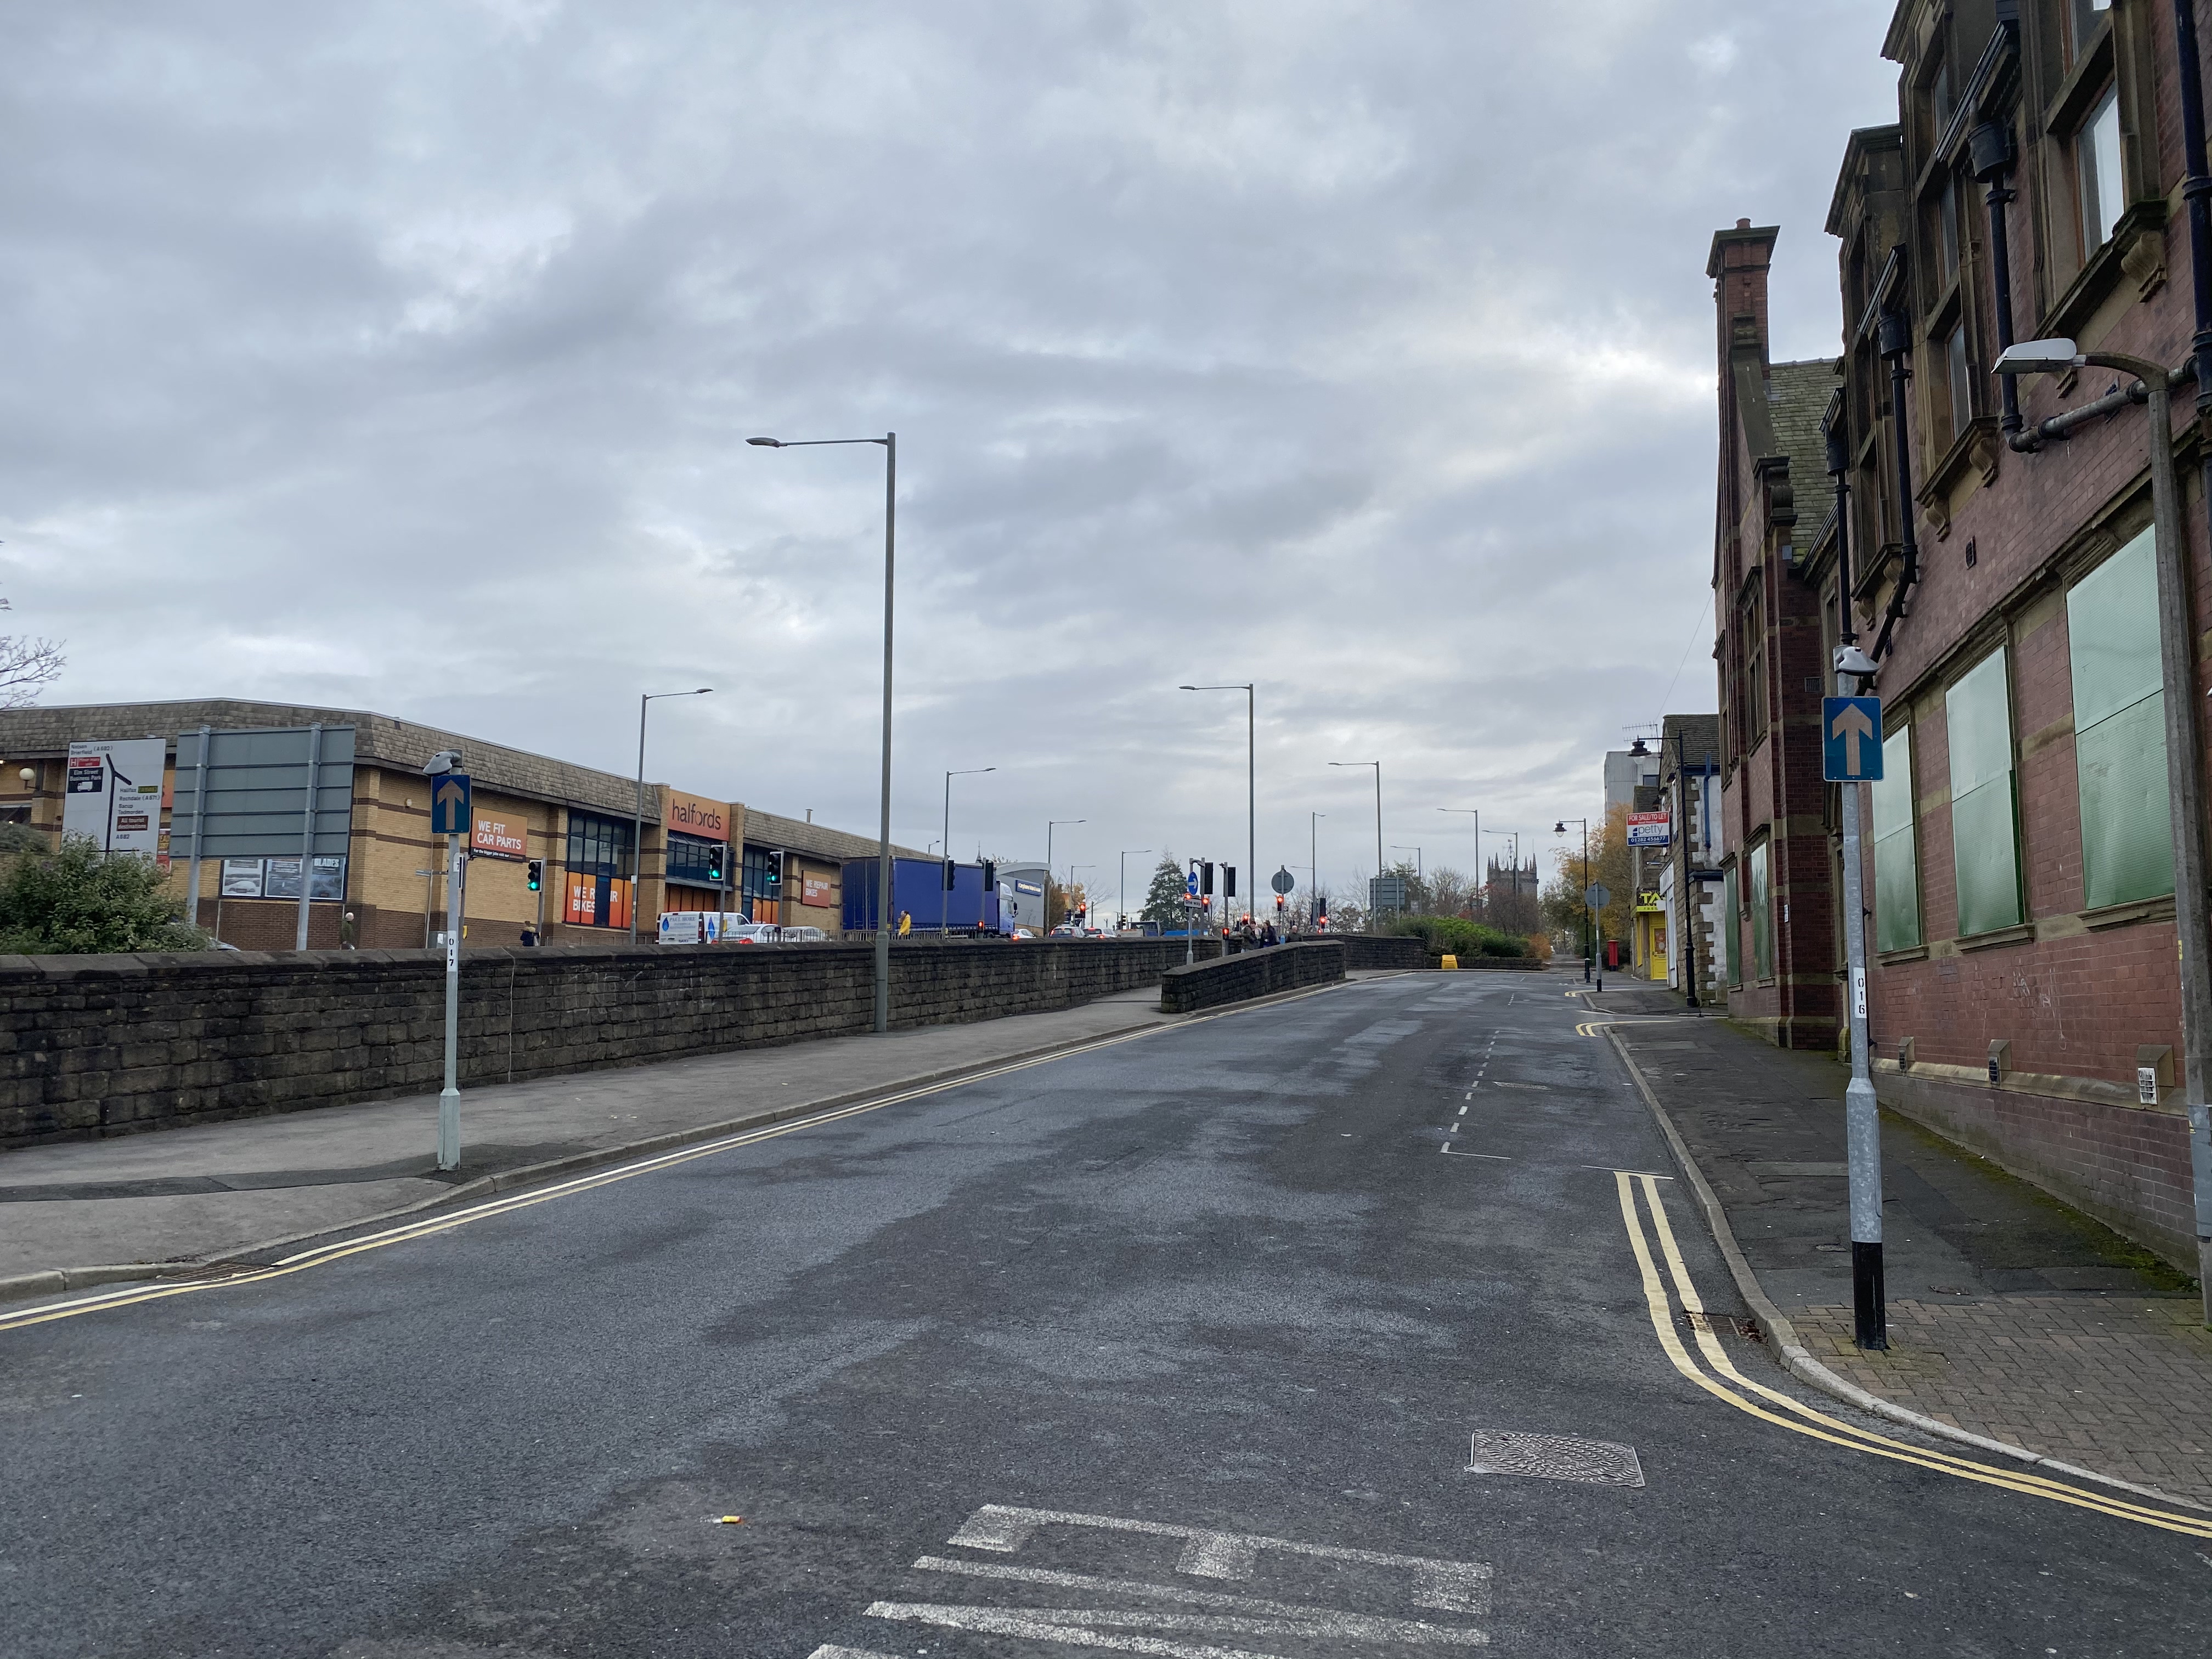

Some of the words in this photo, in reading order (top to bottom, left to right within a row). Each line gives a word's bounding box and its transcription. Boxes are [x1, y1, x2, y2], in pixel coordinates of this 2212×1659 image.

[70, 758, 77, 766] H
[672, 798, 721, 830] halfords
[478, 820, 491, 832] WE
[493, 823, 505, 834] FIT
[1639, 824, 1663, 837] petty
[477, 833, 494, 845] CAR
[496, 836, 521, 850] PARTS
[313, 857, 340, 867] BLADES
[573, 885, 586, 899] WE
[814, 881, 828, 890] REPAIR
[805, 888, 817, 897] BIKES
[573, 899, 595, 913] BIKES
